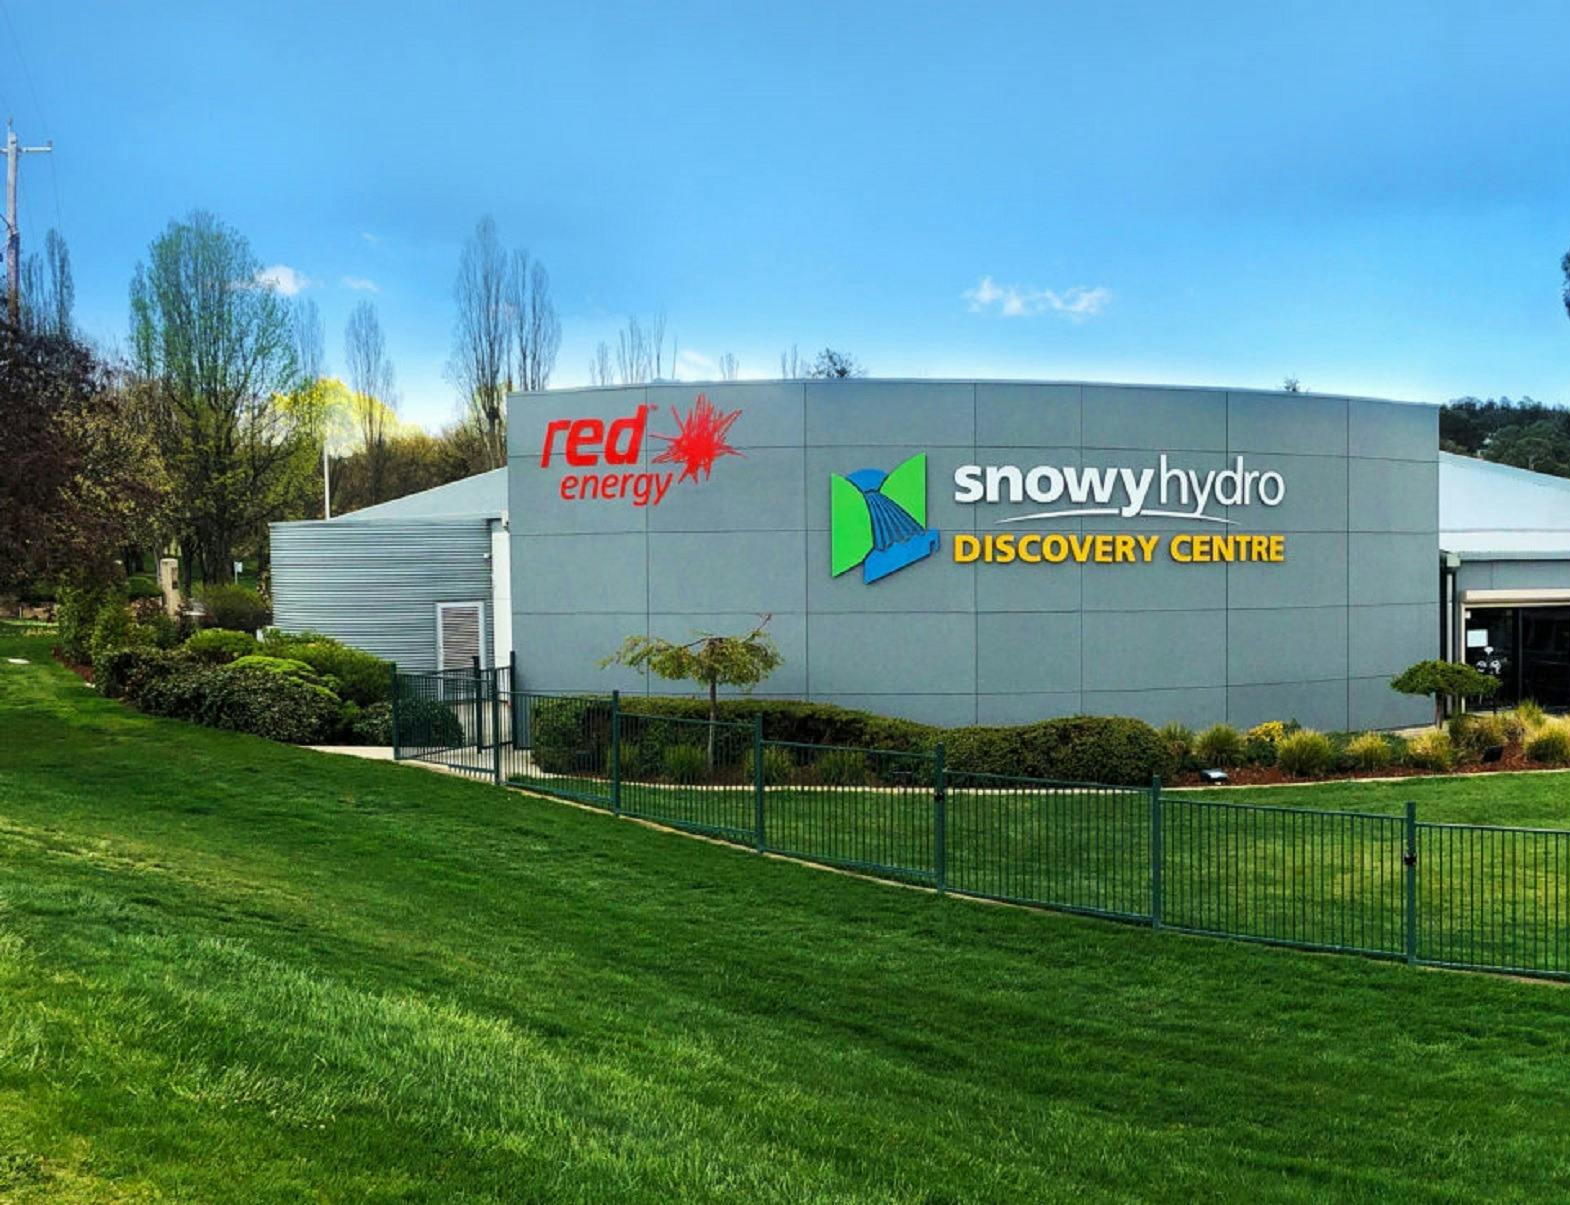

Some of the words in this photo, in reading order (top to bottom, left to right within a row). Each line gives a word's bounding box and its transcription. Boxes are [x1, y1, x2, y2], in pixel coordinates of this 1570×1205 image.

[540, 404, 647, 468] red
[560, 471, 673, 507] energy
[954, 454, 1286, 517] snowyhydro
[954, 534, 1159, 562] DISCOVERY
[1170, 535, 1285, 562] CENTRE
